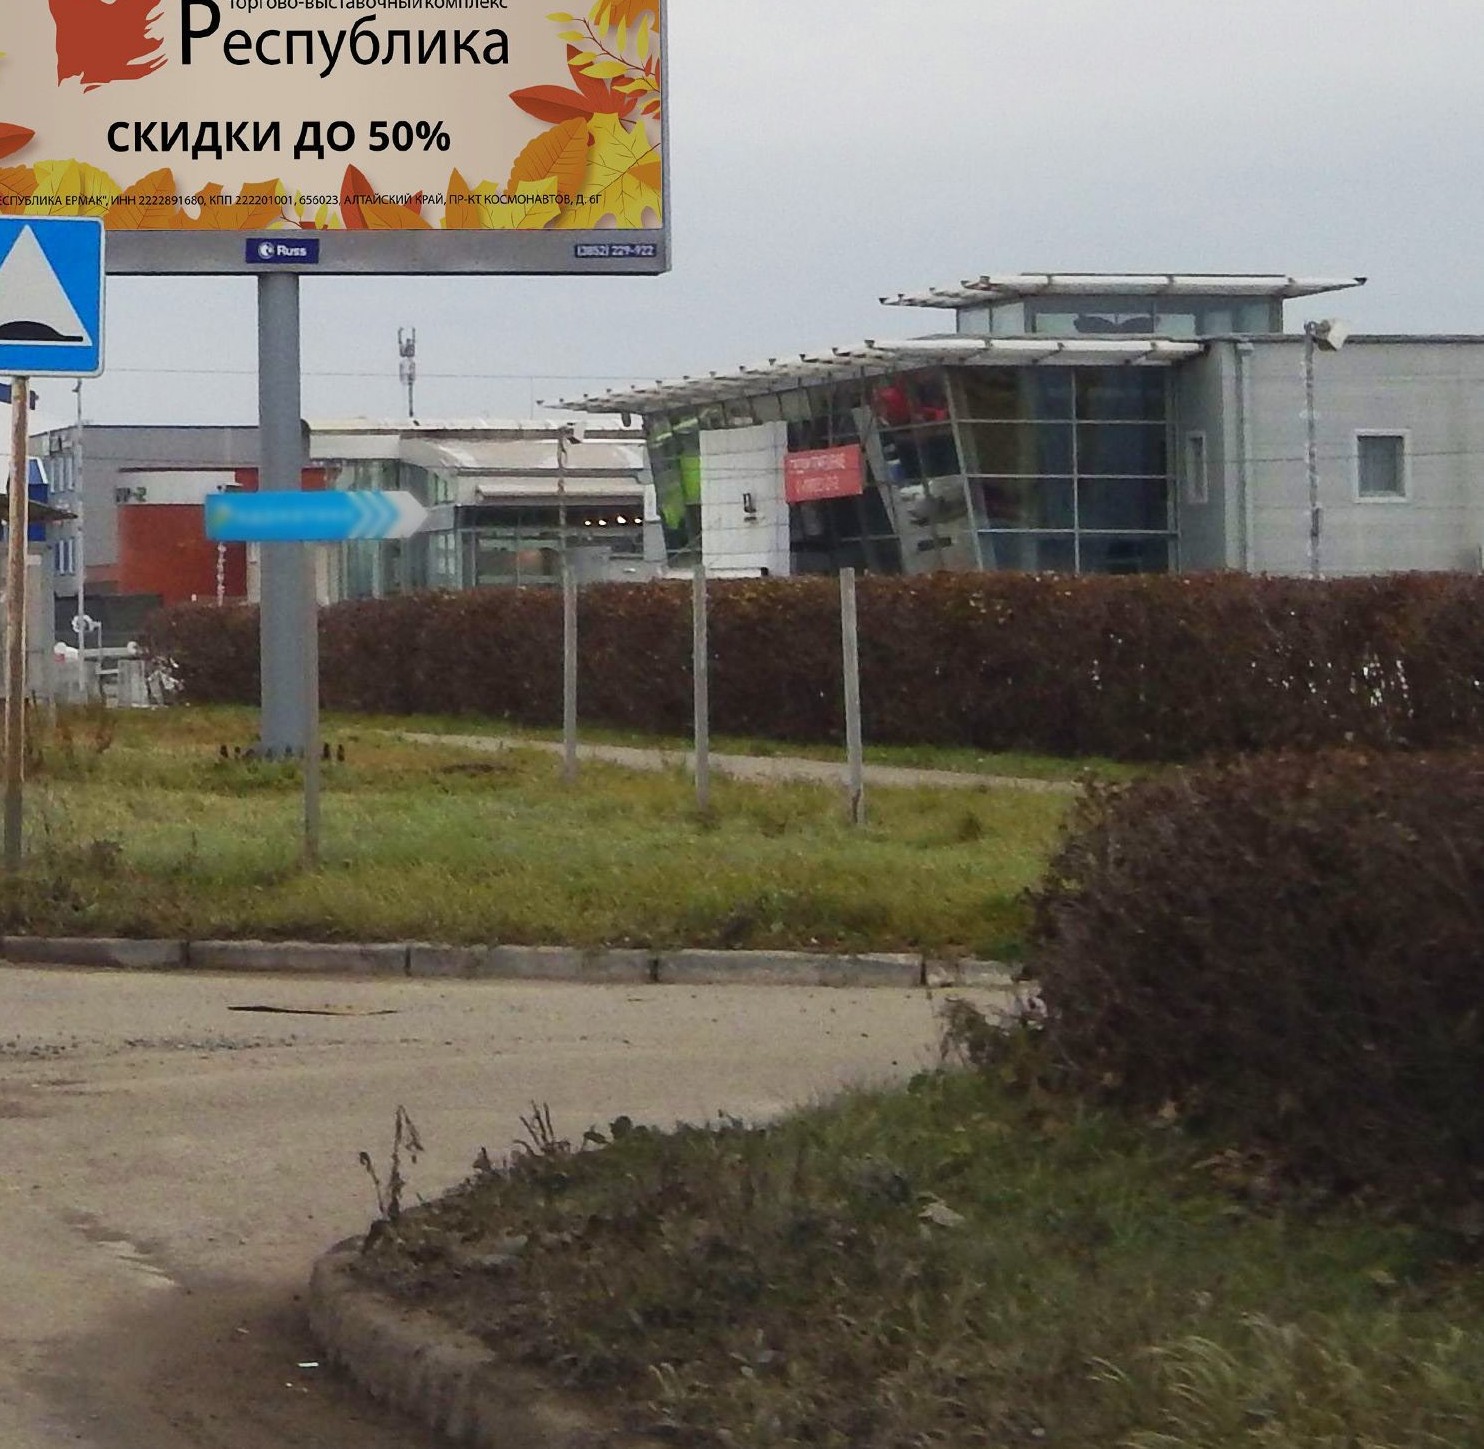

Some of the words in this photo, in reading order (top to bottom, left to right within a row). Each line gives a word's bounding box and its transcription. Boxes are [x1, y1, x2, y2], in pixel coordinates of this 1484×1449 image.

[107, 121, 281, 160] СКИДКИ
[293, 121, 356, 160] ДО
[368, 120, 451, 152] 50%
[111, 195, 136, 206] ИНН
[209, 195, 232, 205] КПП
[235, 195, 297, 207] 222201001,
[299, 195, 342, 206] 656023,
[344, 192, 412, 205] АЛТАЙСКИЙ
[415, 192, 446, 206] КРАЙ,
[449, 194, 482, 205] ПР-КТ
[484, 194, 573, 206] КОСМОНАВТОВ,
[589, 194, 602, 205] 6Г
[276, 244, 307, 257] Russ
